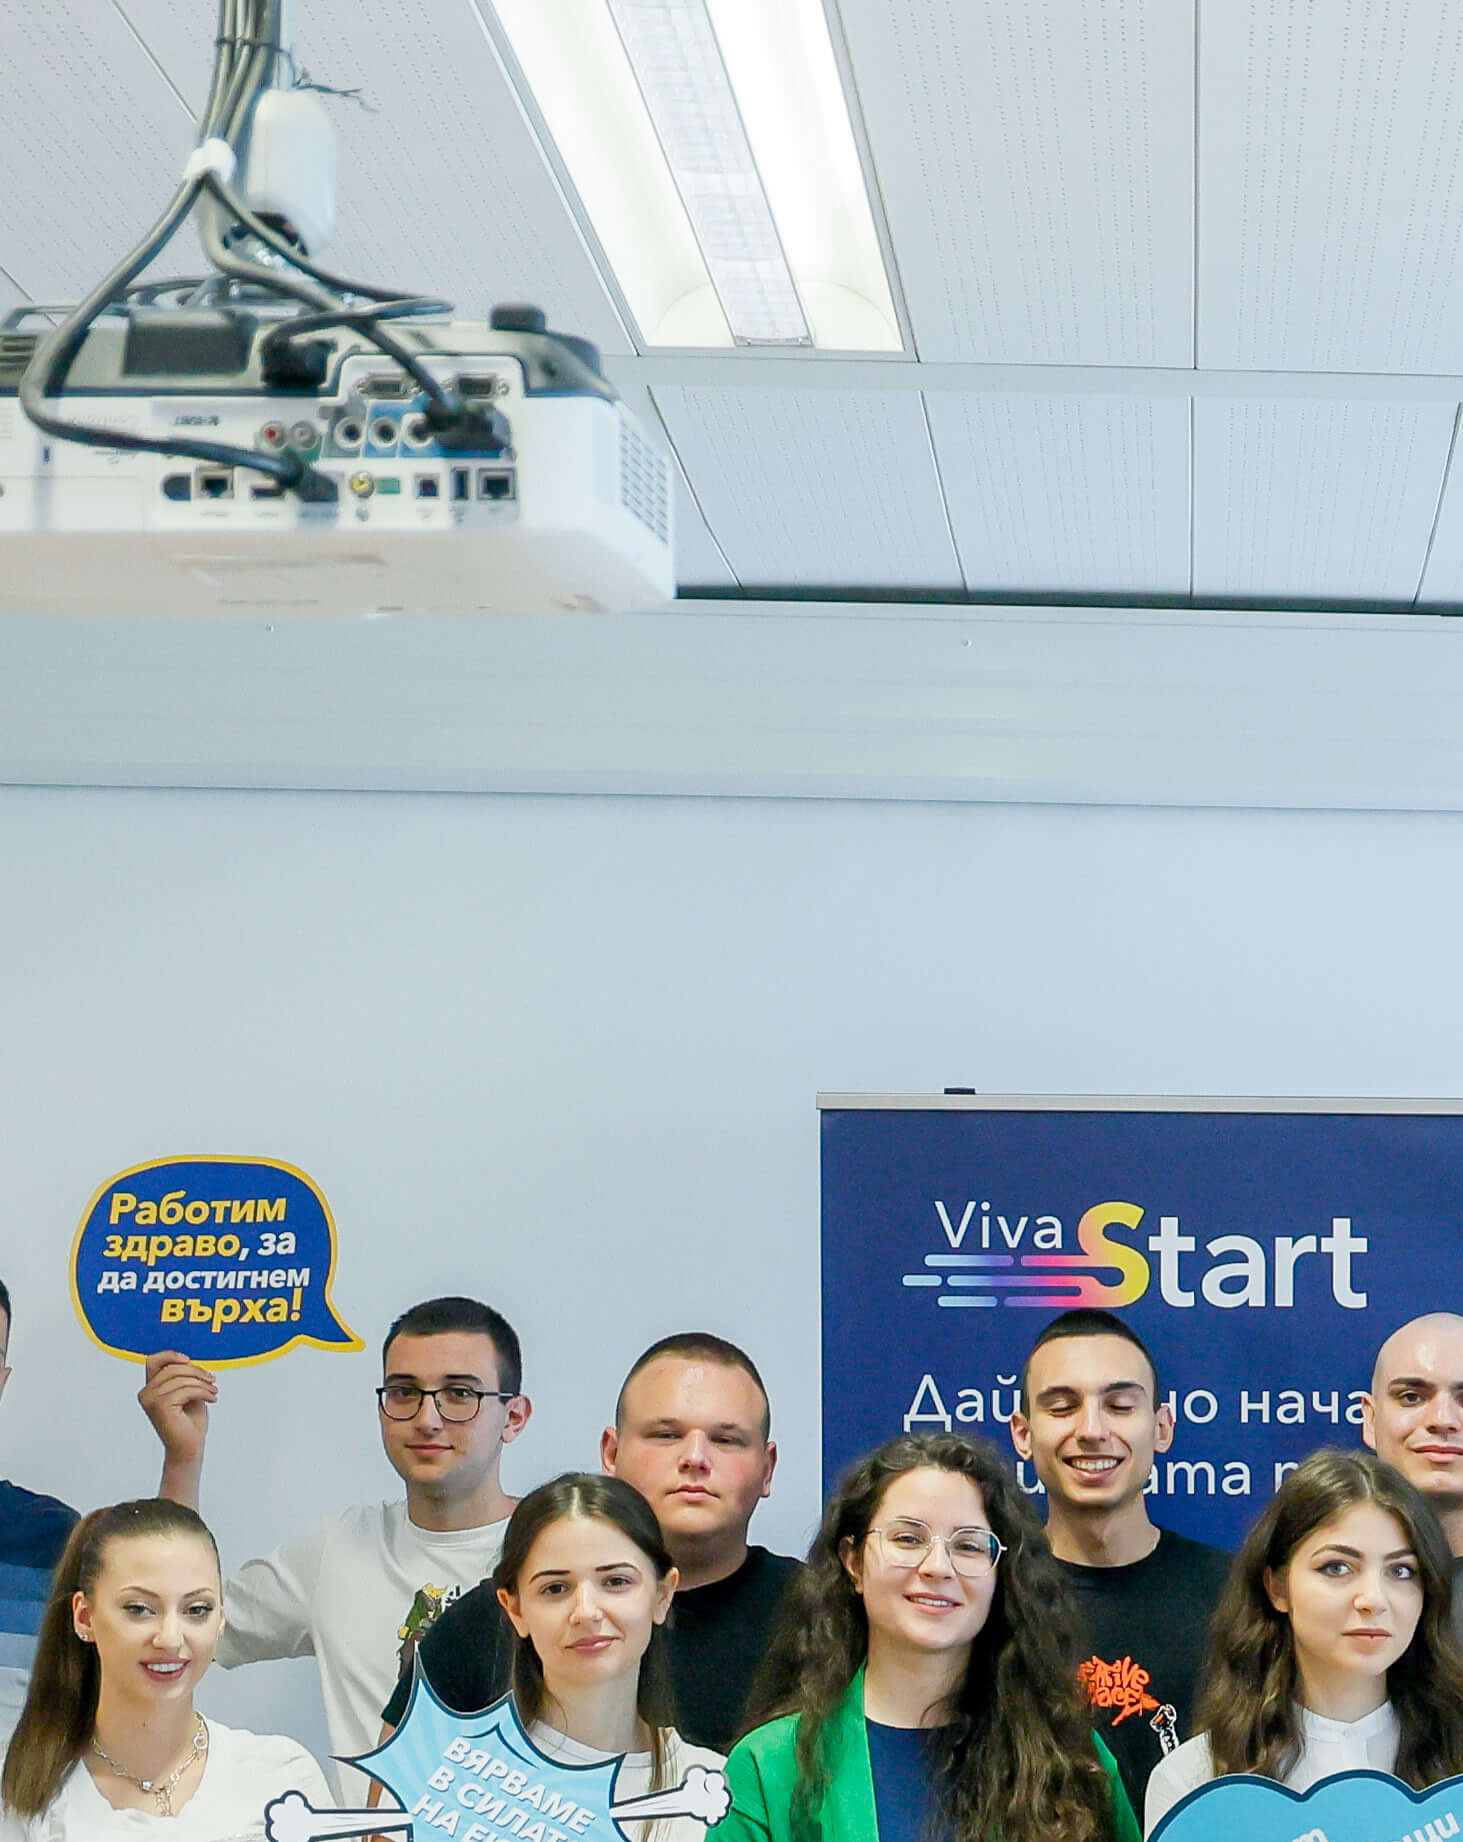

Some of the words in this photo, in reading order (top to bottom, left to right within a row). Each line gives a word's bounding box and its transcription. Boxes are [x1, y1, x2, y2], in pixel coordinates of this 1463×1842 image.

[108, 1190, 287, 1225] Работим
[102, 1233, 249, 1266] здраво,
[256, 1232, 297, 1256] за
[934, 1200, 1064, 1250] Viva
[1077, 1201, 1369, 1310] Start
[96, 1269, 138, 1294] да
[142, 1267, 311, 1294] достигнем
[160, 1287, 303, 1333] върха!
[903, 1374, 1022, 1433] Дай
[426, 1764, 456, 1792] В
[442, 1736, 597, 1836] ВЯРВАМЕ
[411, 1794, 457, 1839] НА
